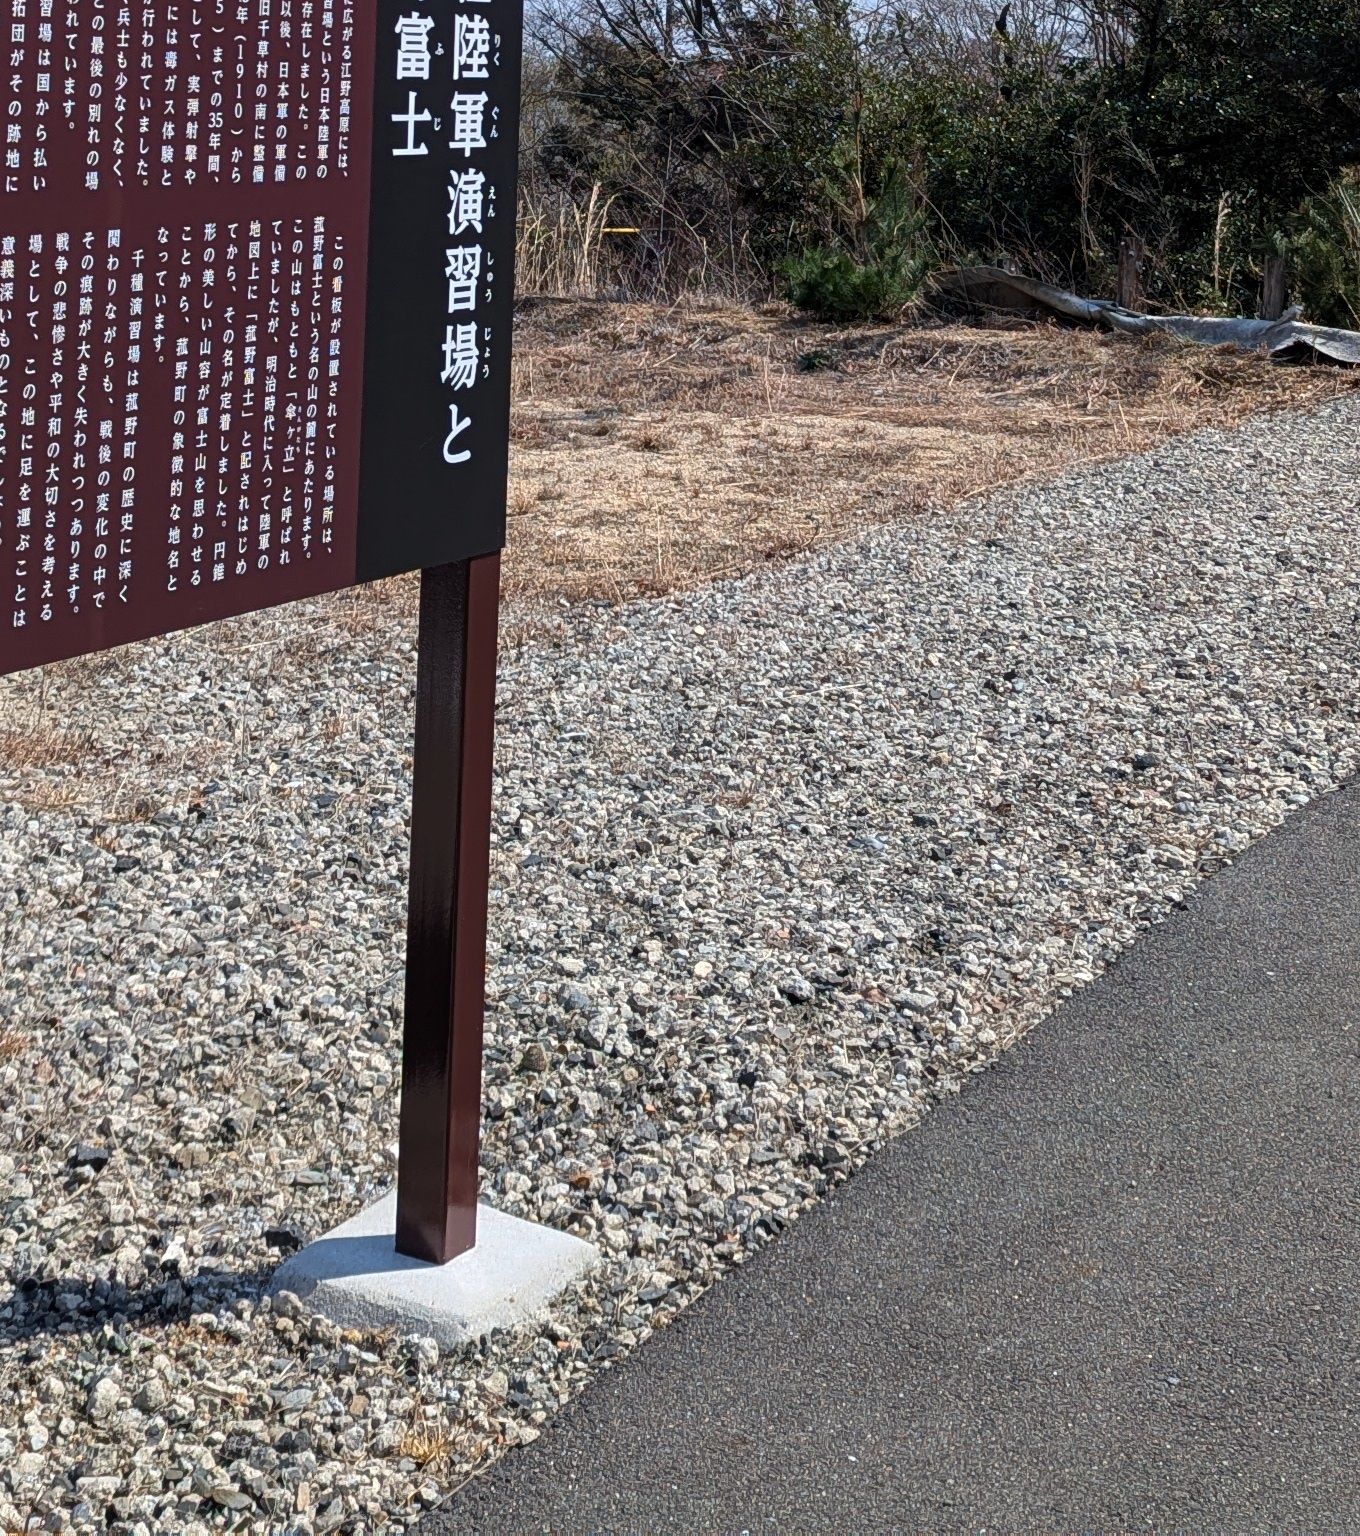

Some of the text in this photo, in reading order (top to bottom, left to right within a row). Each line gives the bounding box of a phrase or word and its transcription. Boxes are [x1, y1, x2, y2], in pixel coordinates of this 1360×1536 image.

[492, 34, 501, 66] りく
[433, 116, 441, 132] じ
[490, 106, 500, 139] ぐん
